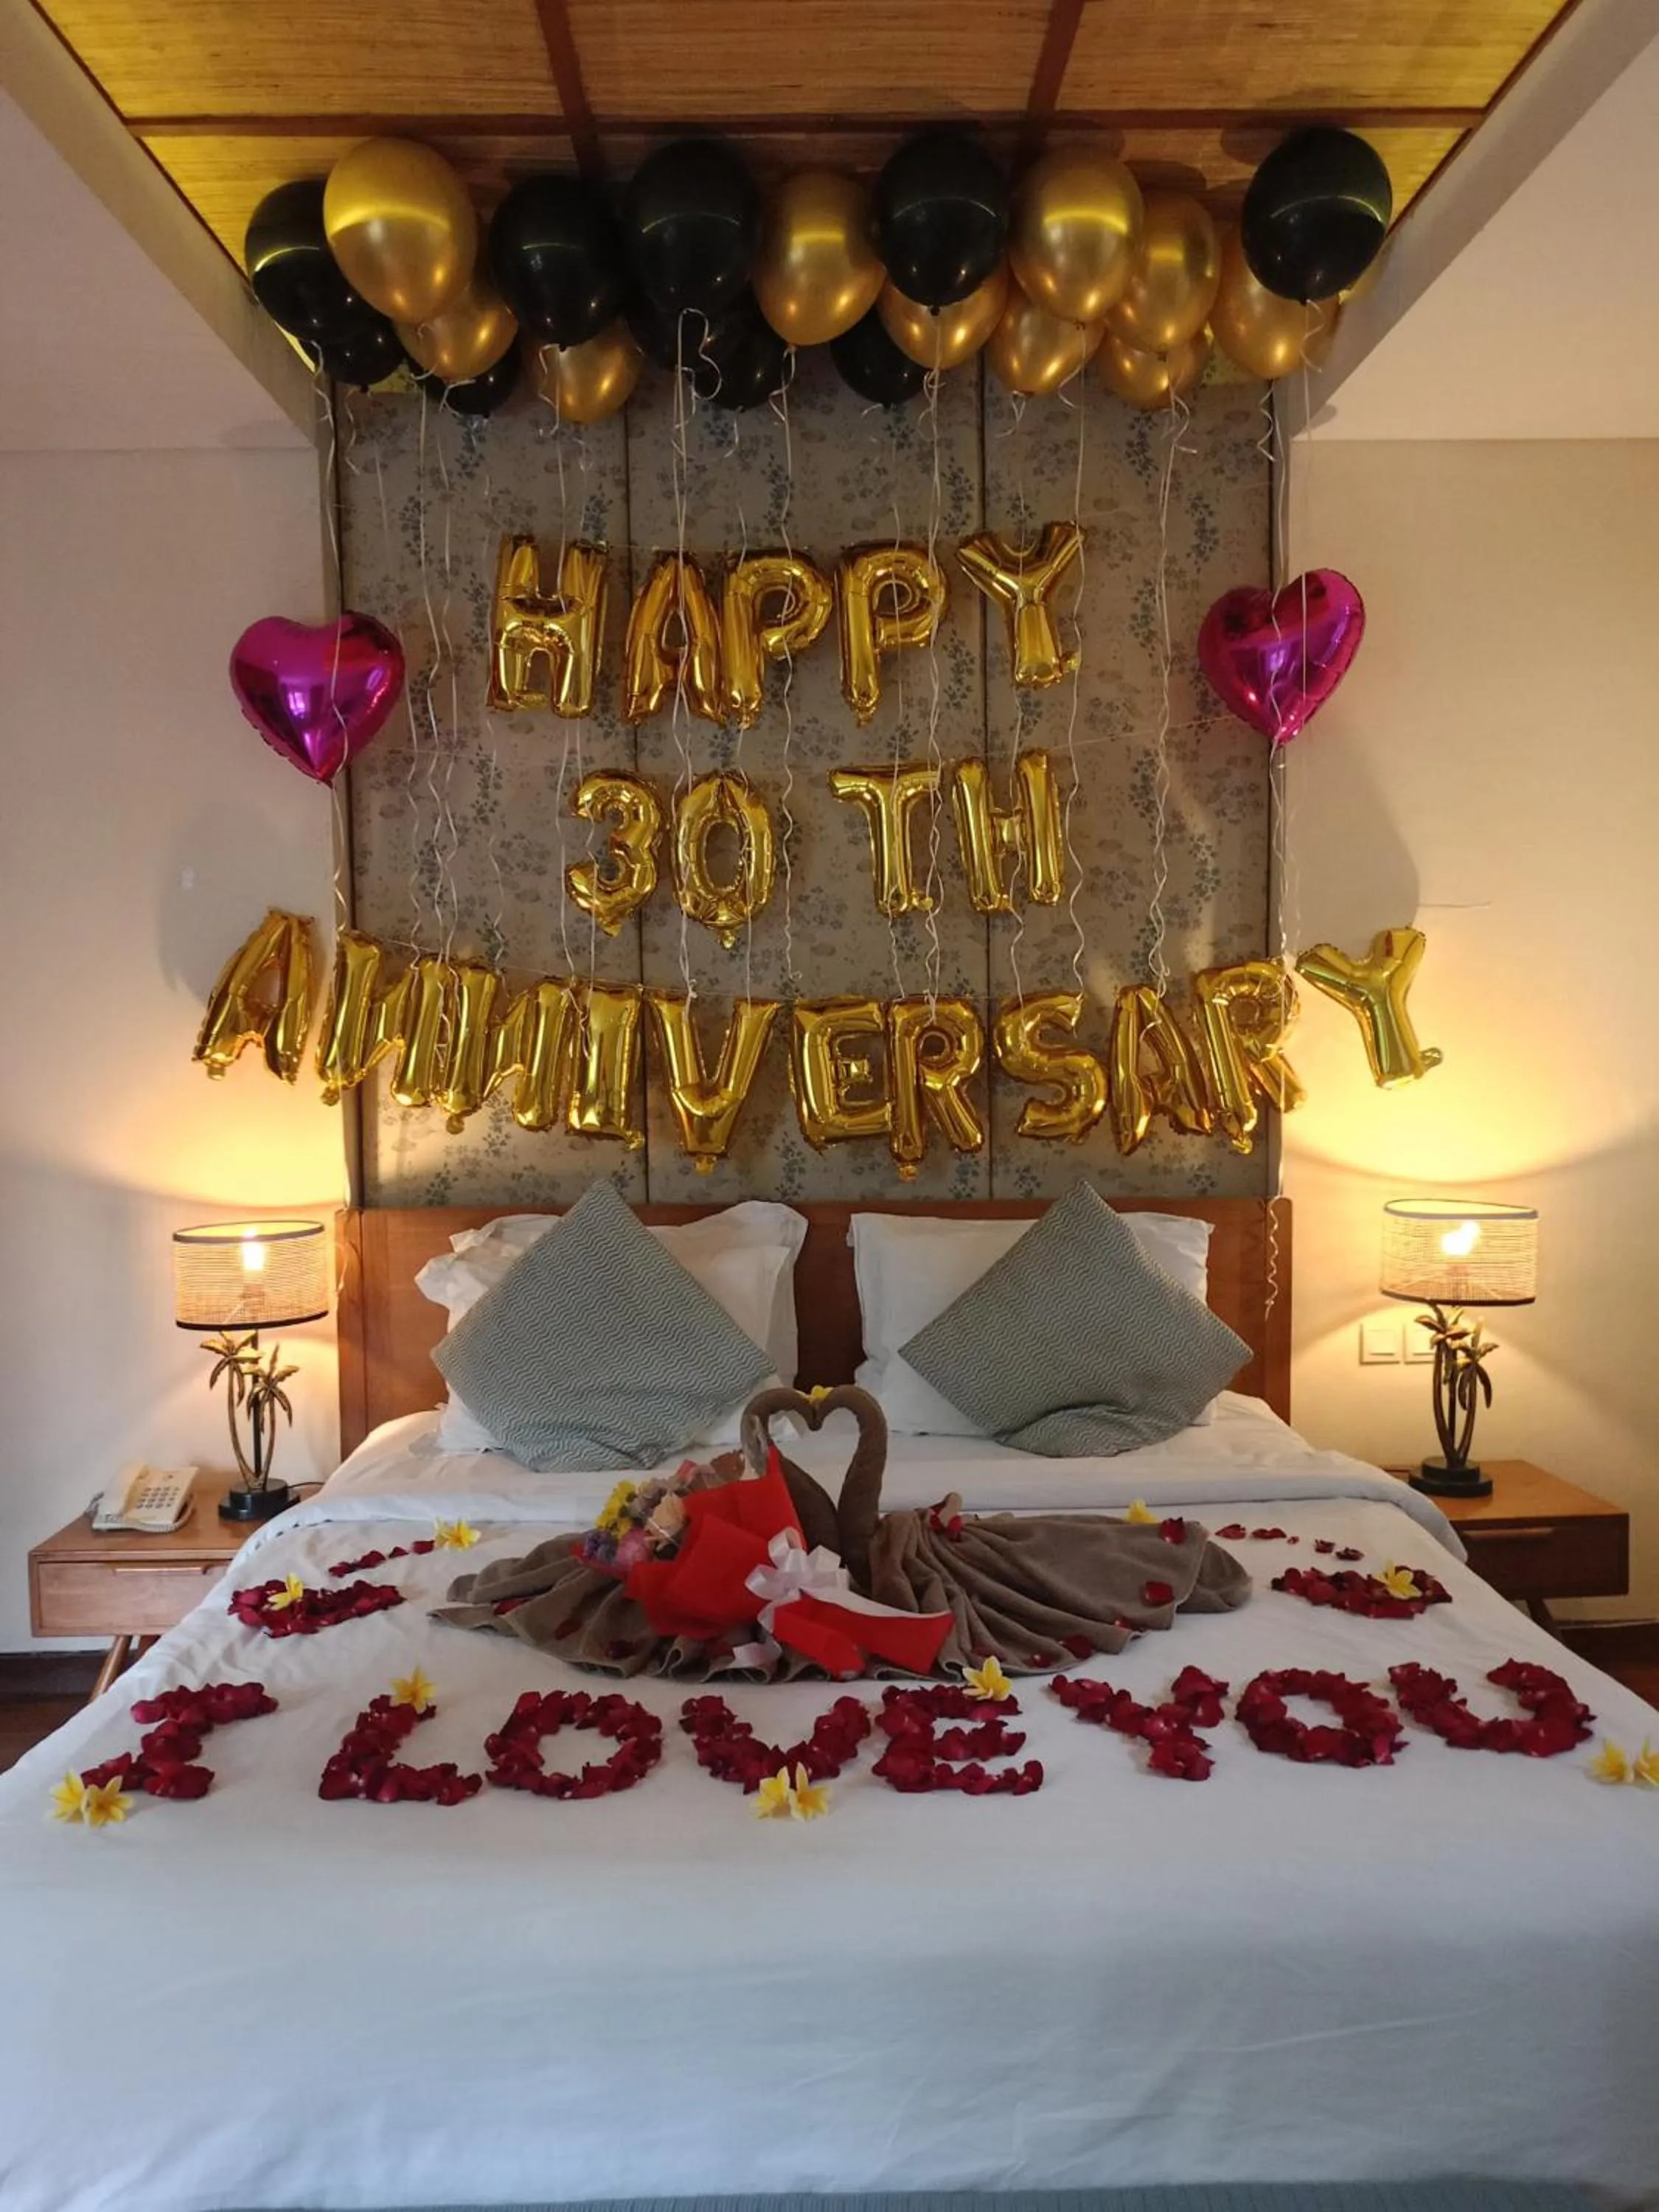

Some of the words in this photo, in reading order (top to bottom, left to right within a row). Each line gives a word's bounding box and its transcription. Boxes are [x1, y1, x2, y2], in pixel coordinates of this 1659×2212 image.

[487, 520, 1088, 728] HAPPY
[566, 770, 776, 949] 30
[830, 748, 1065, 917] TH
[192, 908, 1444, 1180] ANNIVERSARY
[81, 1682, 279, 1799] I
[319, 1683, 1043, 1804] LOVE
[1048, 1658, 1593, 1781] YOU
